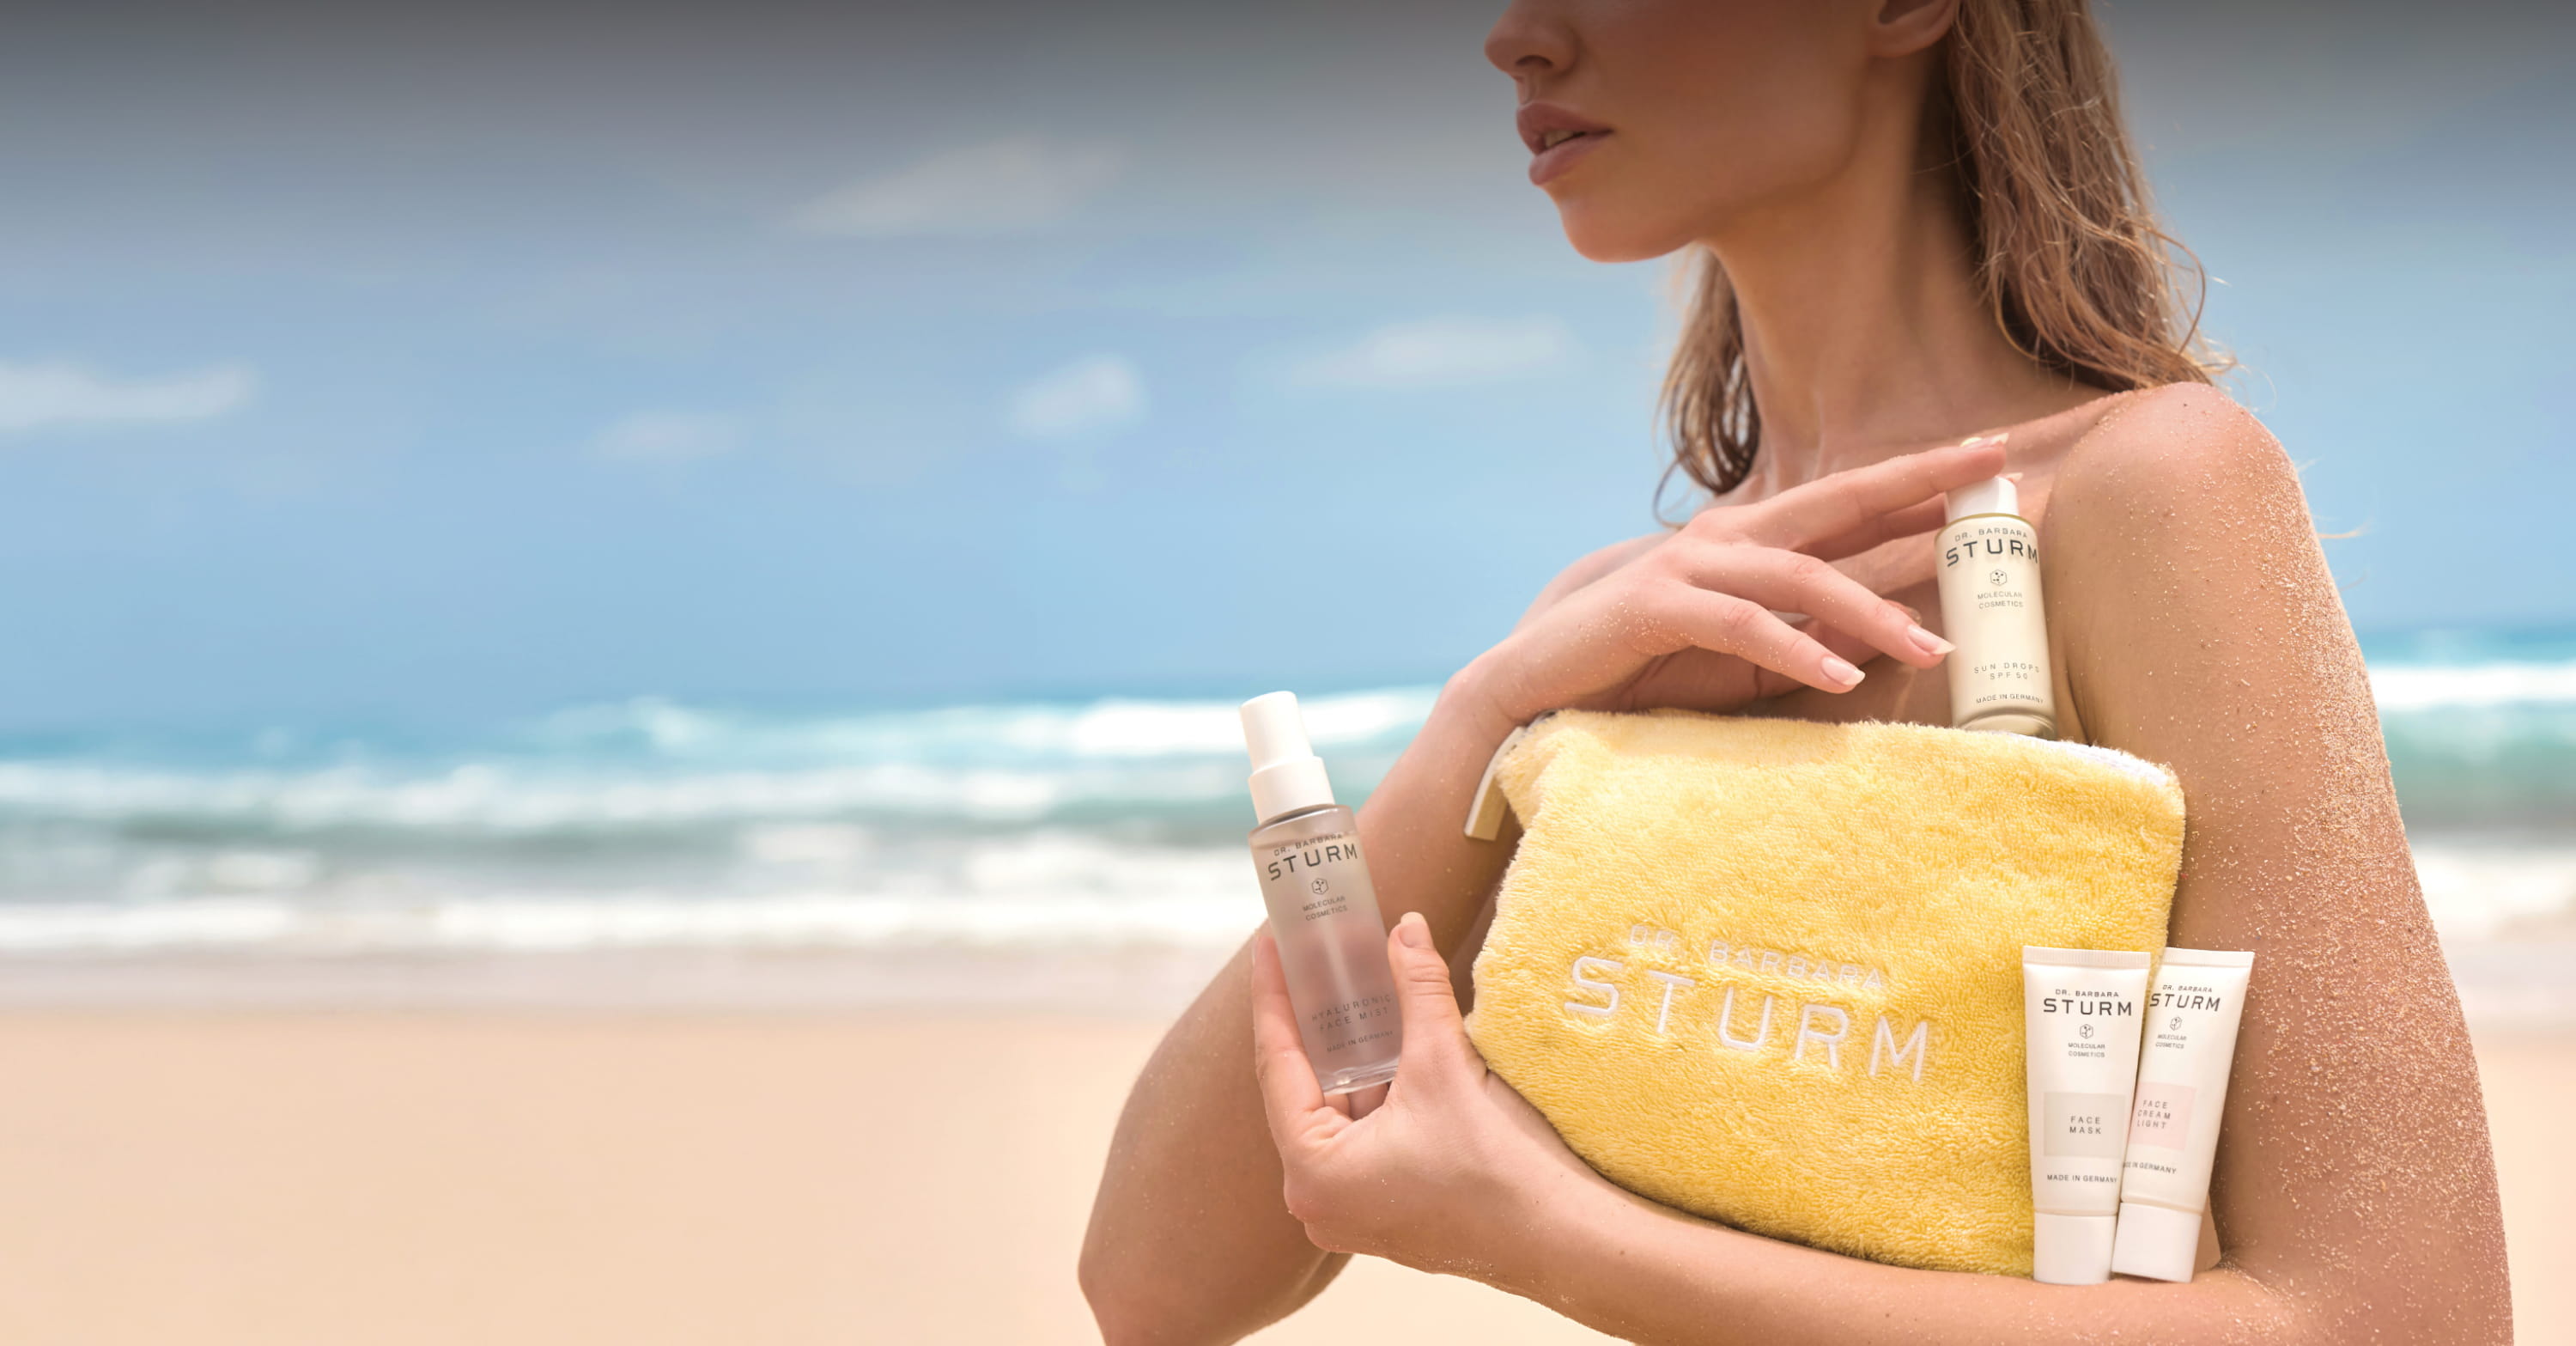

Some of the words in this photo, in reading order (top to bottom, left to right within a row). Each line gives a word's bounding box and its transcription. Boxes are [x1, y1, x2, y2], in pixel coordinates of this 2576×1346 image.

[1954, 531, 1973, 543] DR.
[1978, 527, 2027, 539] BARBARA
[1946, 538, 2038, 568] STURM
[1978, 590, 2023, 600] MOLECULAR
[1978, 600, 2024, 609] COSMETICS
[1973, 662, 1996, 674] SUN
[2003, 662, 2039, 673] DROPS
[1990, 672, 2011, 680] SPF
[2015, 672, 2028, 680] 50
[1976, 694, 1997, 703] MADE
[2009, 693, 2044, 703] GERMANY
[1273, 845, 1291, 857] DR.
[1295, 833, 1344, 850] BARBARA
[1267, 843, 1358, 881] STURM
[1302, 895, 1346, 911] MOLECULAR
[1305, 904, 1348, 922] COSMETICS
[1709, 939, 1883, 990] BARBARA
[2055, 988, 2071, 996] DR.
[1311, 995, 1391, 1021] HYALURONIC
[2043, 998, 2132, 1016] STURM
[2149, 993, 2221, 1012] STURM
[1320, 1016, 1352, 1031] FACE
[1359, 1006, 1388, 1020] MIST
[1564, 955, 1929, 1082] STURM
[1327, 1041, 1346, 1052] MADE
[1358, 1030, 1394, 1044] GERMANY
[2068, 1050, 2105, 1058] COSMETICS
[2142, 1099, 2168, 1109] FACE
[2070, 1116, 2102, 1124] FACE
[2137, 1109, 2171, 1119] CREAM
[2069, 1126, 2102, 1135] MASK
[2136, 1119, 2167, 1130] LIGHT
[2139, 1161, 2177, 1175] GERMANY
[2083, 1175, 2117, 1184] GERMANY
